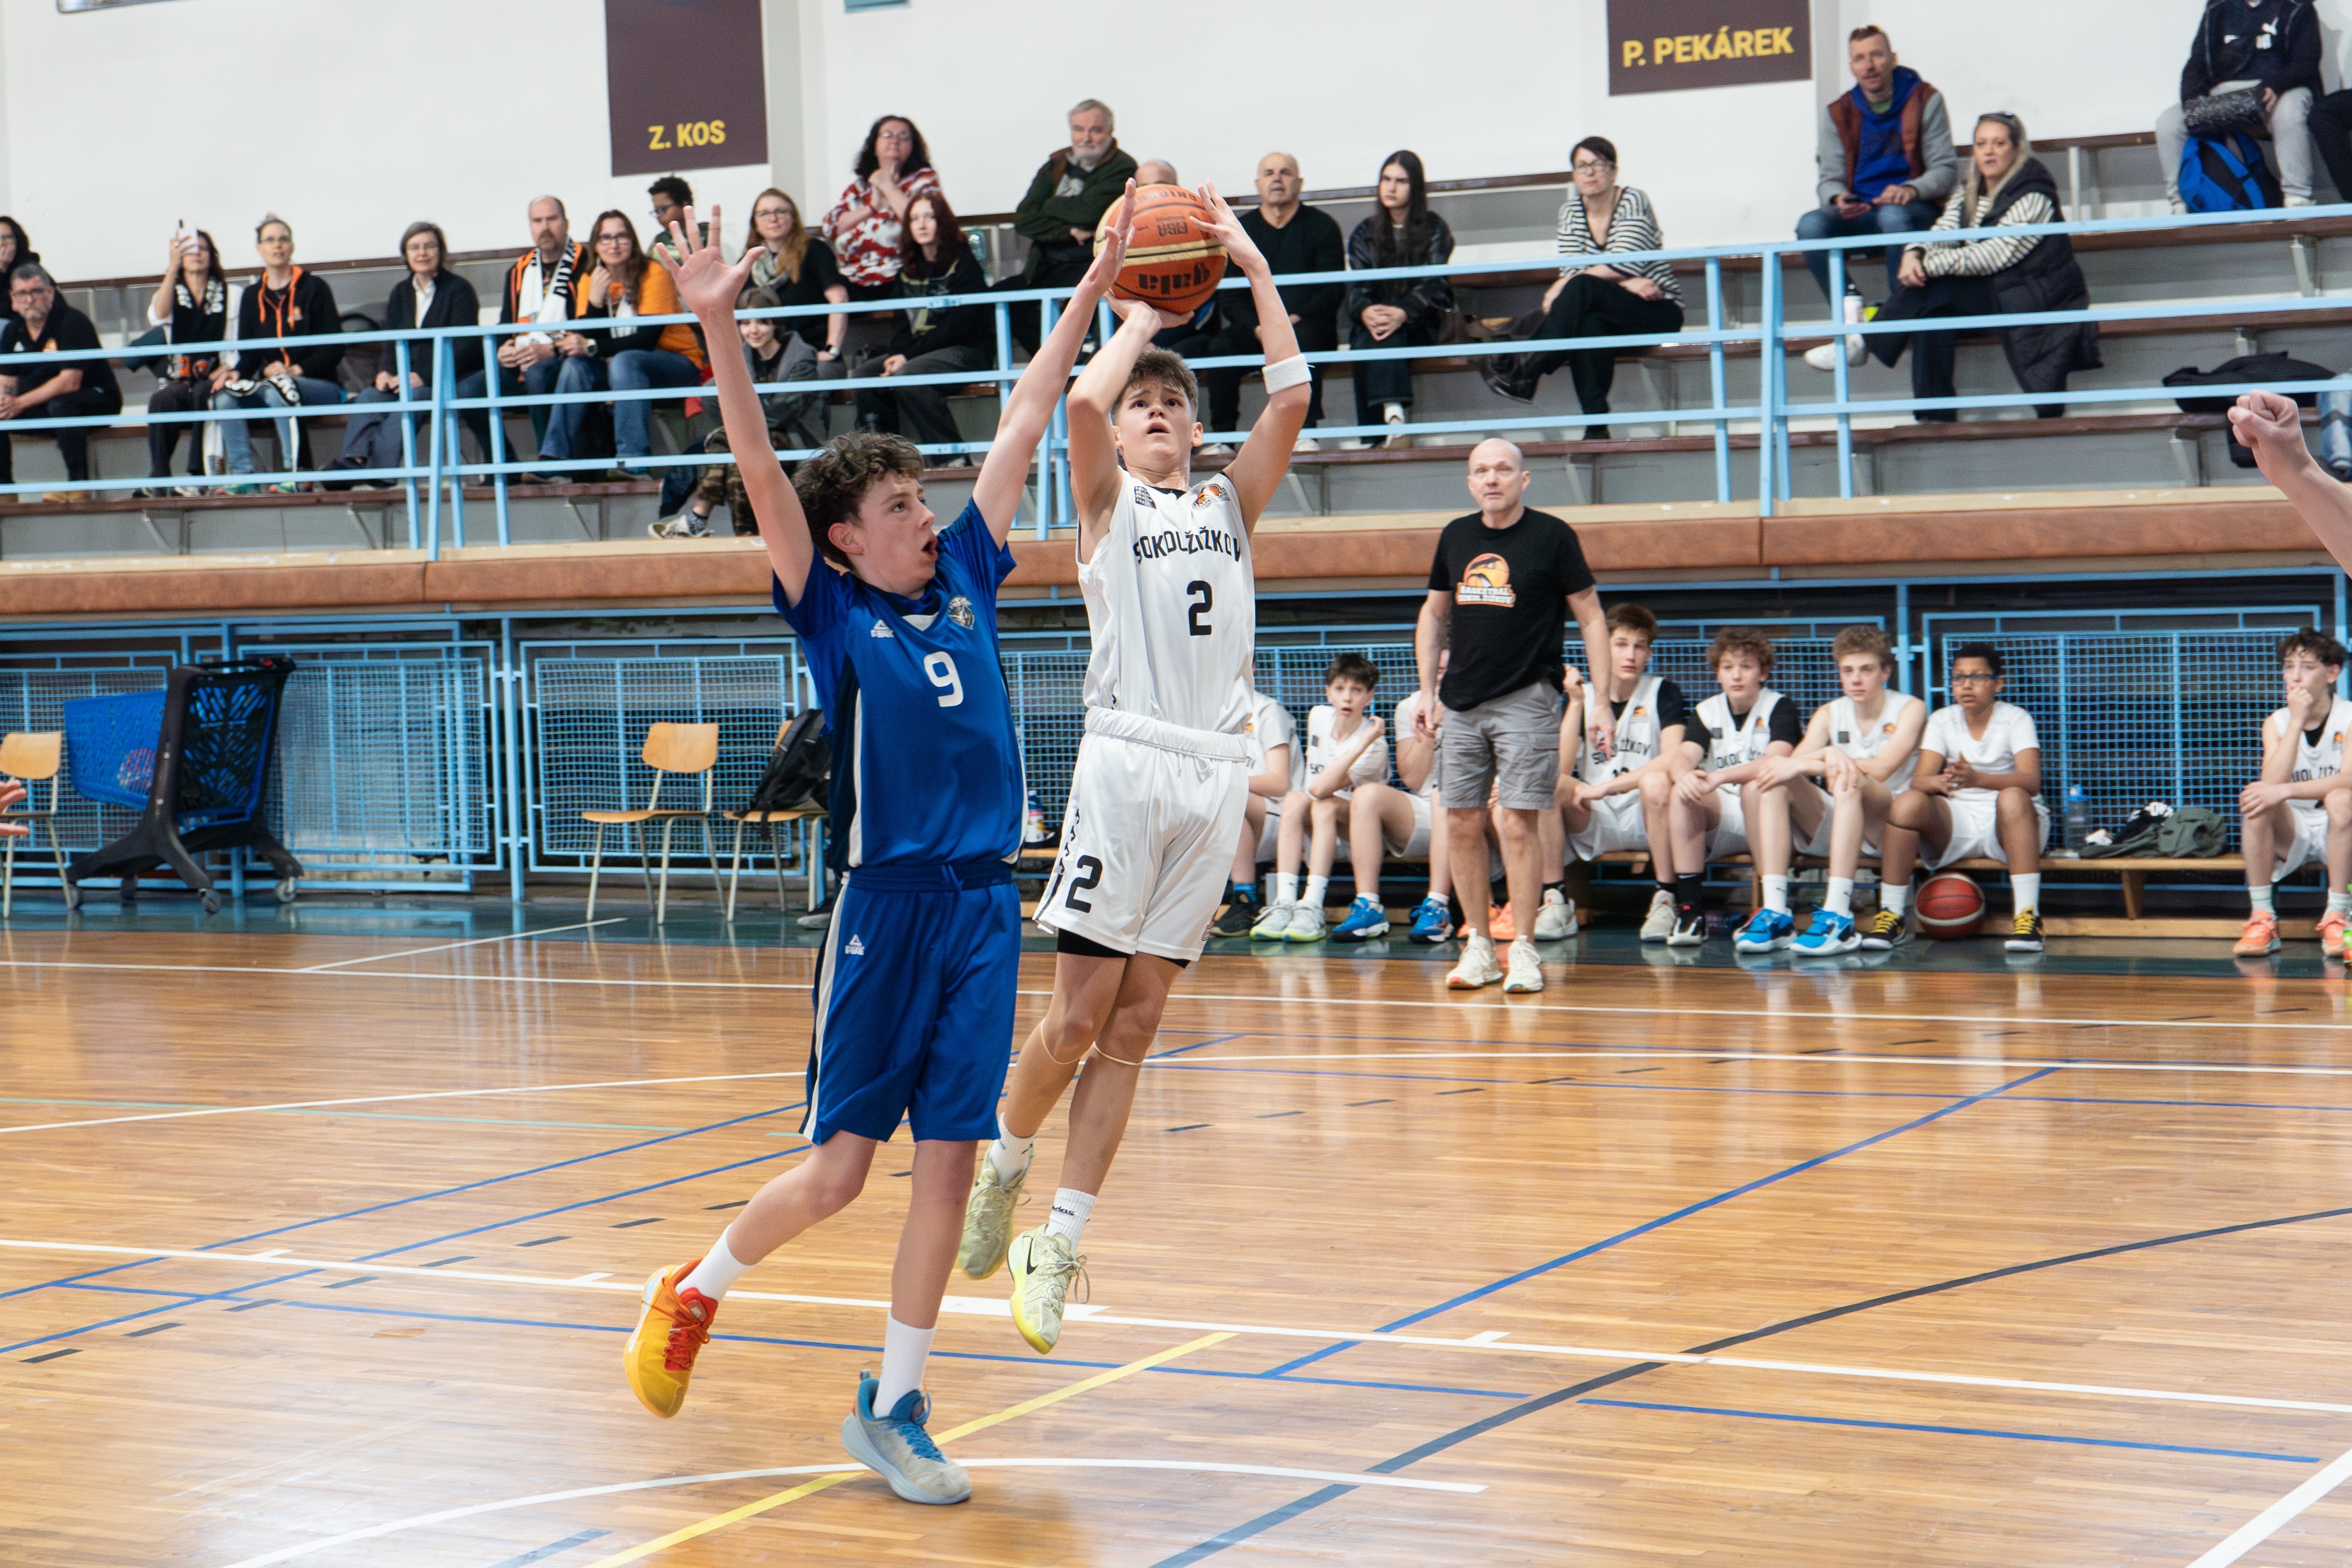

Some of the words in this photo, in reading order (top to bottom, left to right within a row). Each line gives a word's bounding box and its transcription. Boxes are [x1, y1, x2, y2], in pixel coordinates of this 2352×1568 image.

[1622, 41, 1645, 68] P.
[1653, 26, 1794, 64] PEKÁREK
[648, 125, 671, 151] Z.
[677, 119, 726, 148] KOS
[1138, 263, 1211, 295] gala
[1187, 580, 1213, 636] 2
[924, 651, 964, 707] 9
[1065, 854, 1103, 914] 2
